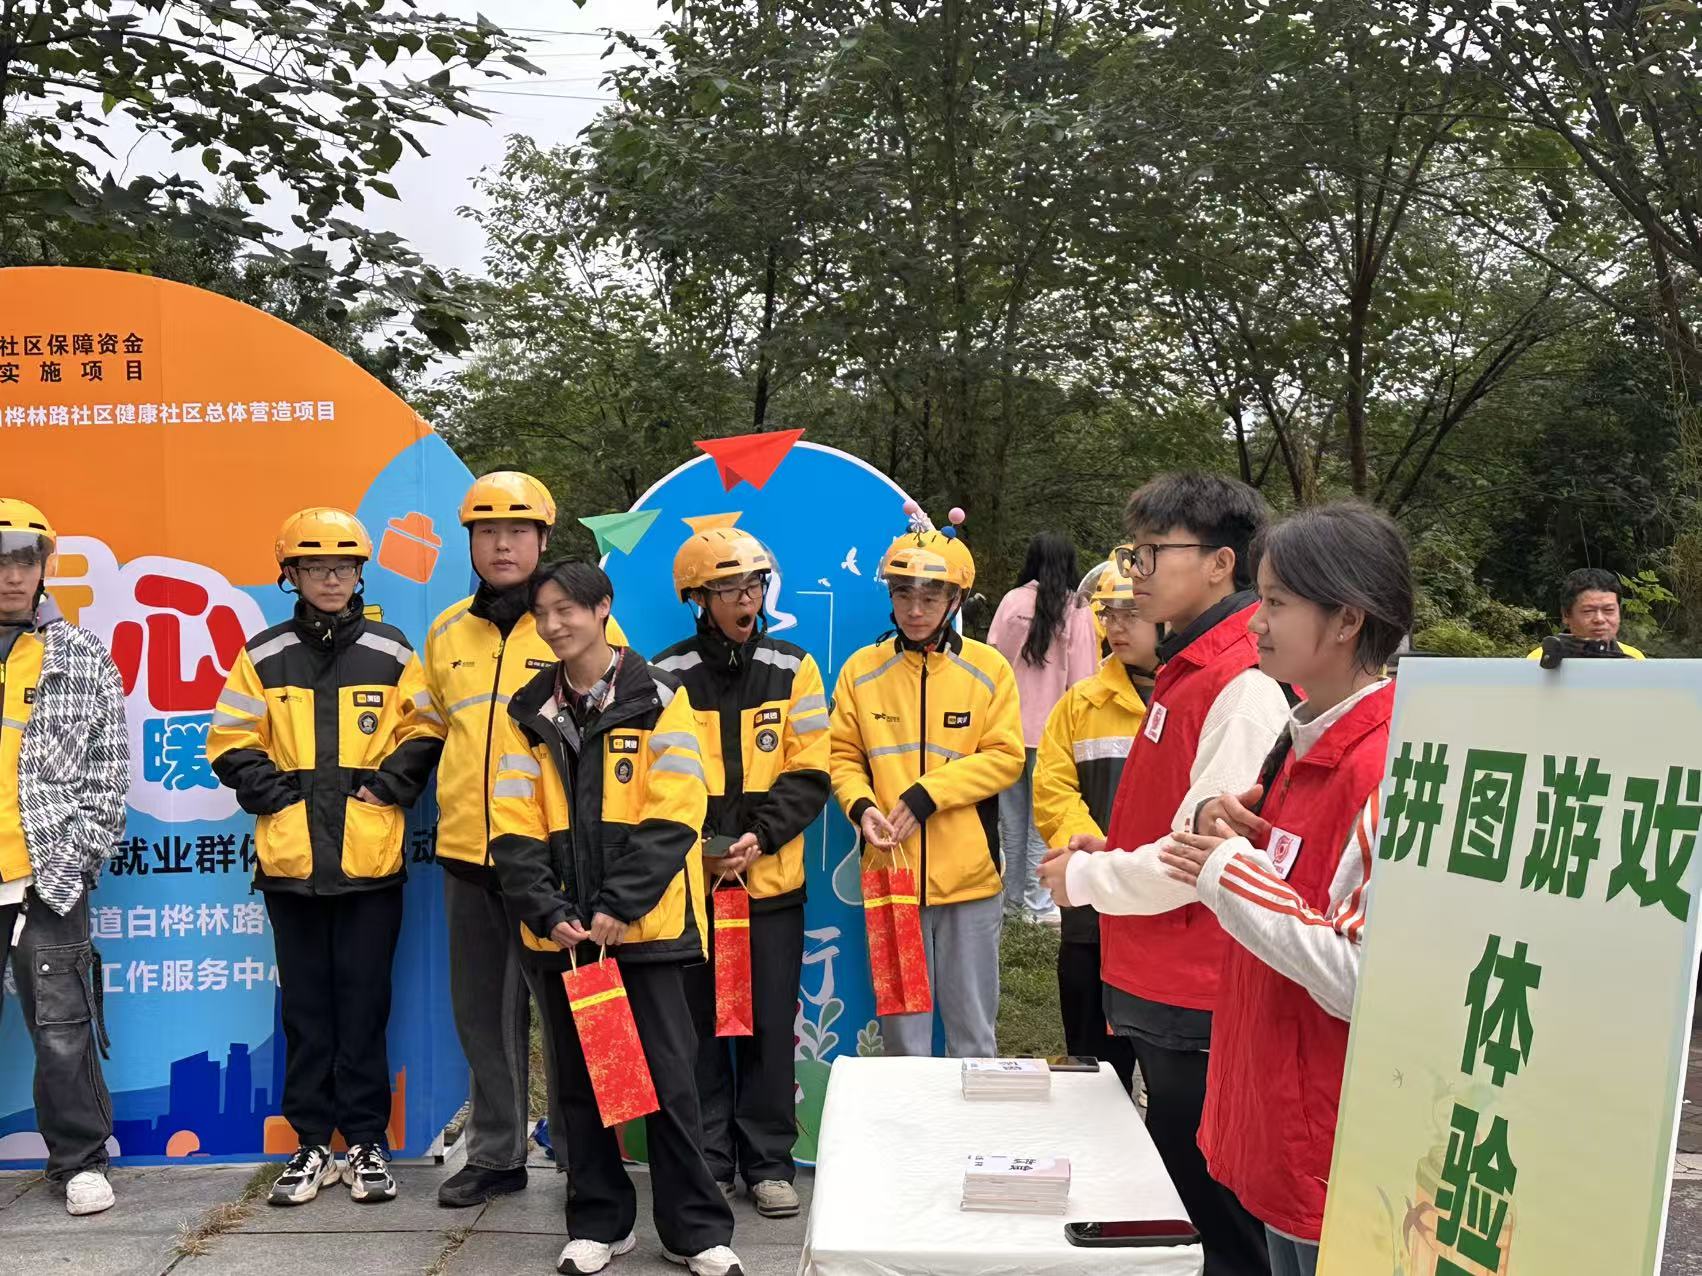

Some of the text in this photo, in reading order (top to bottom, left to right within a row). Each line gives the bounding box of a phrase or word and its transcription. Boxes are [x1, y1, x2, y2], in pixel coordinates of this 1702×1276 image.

[0, 333, 144, 356] 社区保障资金
[0, 401, 335, 427] 桦林路社区健康社区总体营造项目
[1378, 742, 1702, 923] 拼图游戏
[99, 833, 258, 875] 就业群
[91, 902, 273, 938] 道白桦林路
[1434, 934, 1542, 1276] 体验
